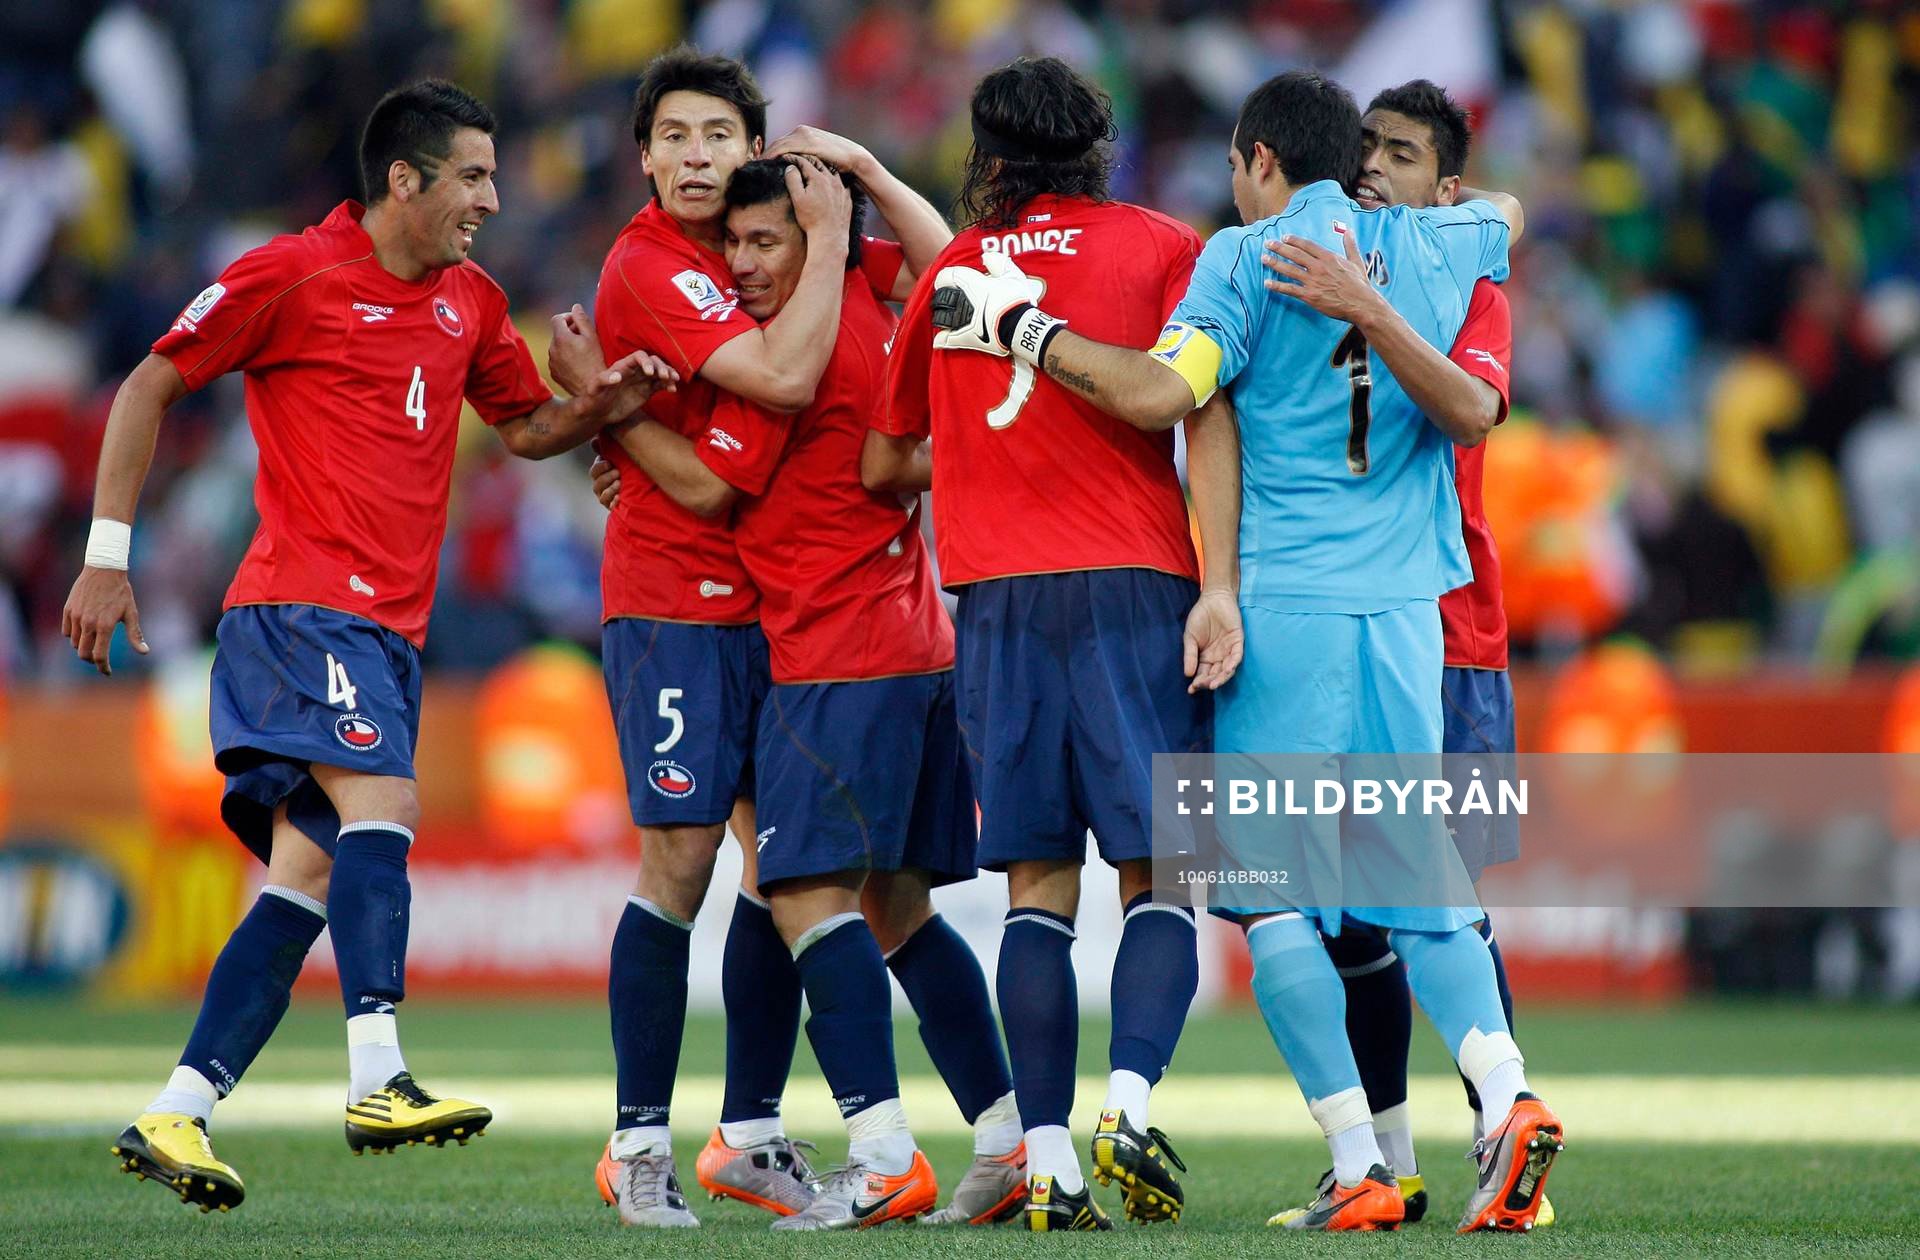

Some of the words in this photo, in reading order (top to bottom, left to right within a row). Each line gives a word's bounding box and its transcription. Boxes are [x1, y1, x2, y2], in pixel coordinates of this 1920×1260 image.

[352, 302, 394, 314] BROOKS
[405, 365, 427, 431] 4
[1330, 322, 1373, 475] 1
[326, 653, 357, 710] 4
[654, 688, 684, 753] 5
